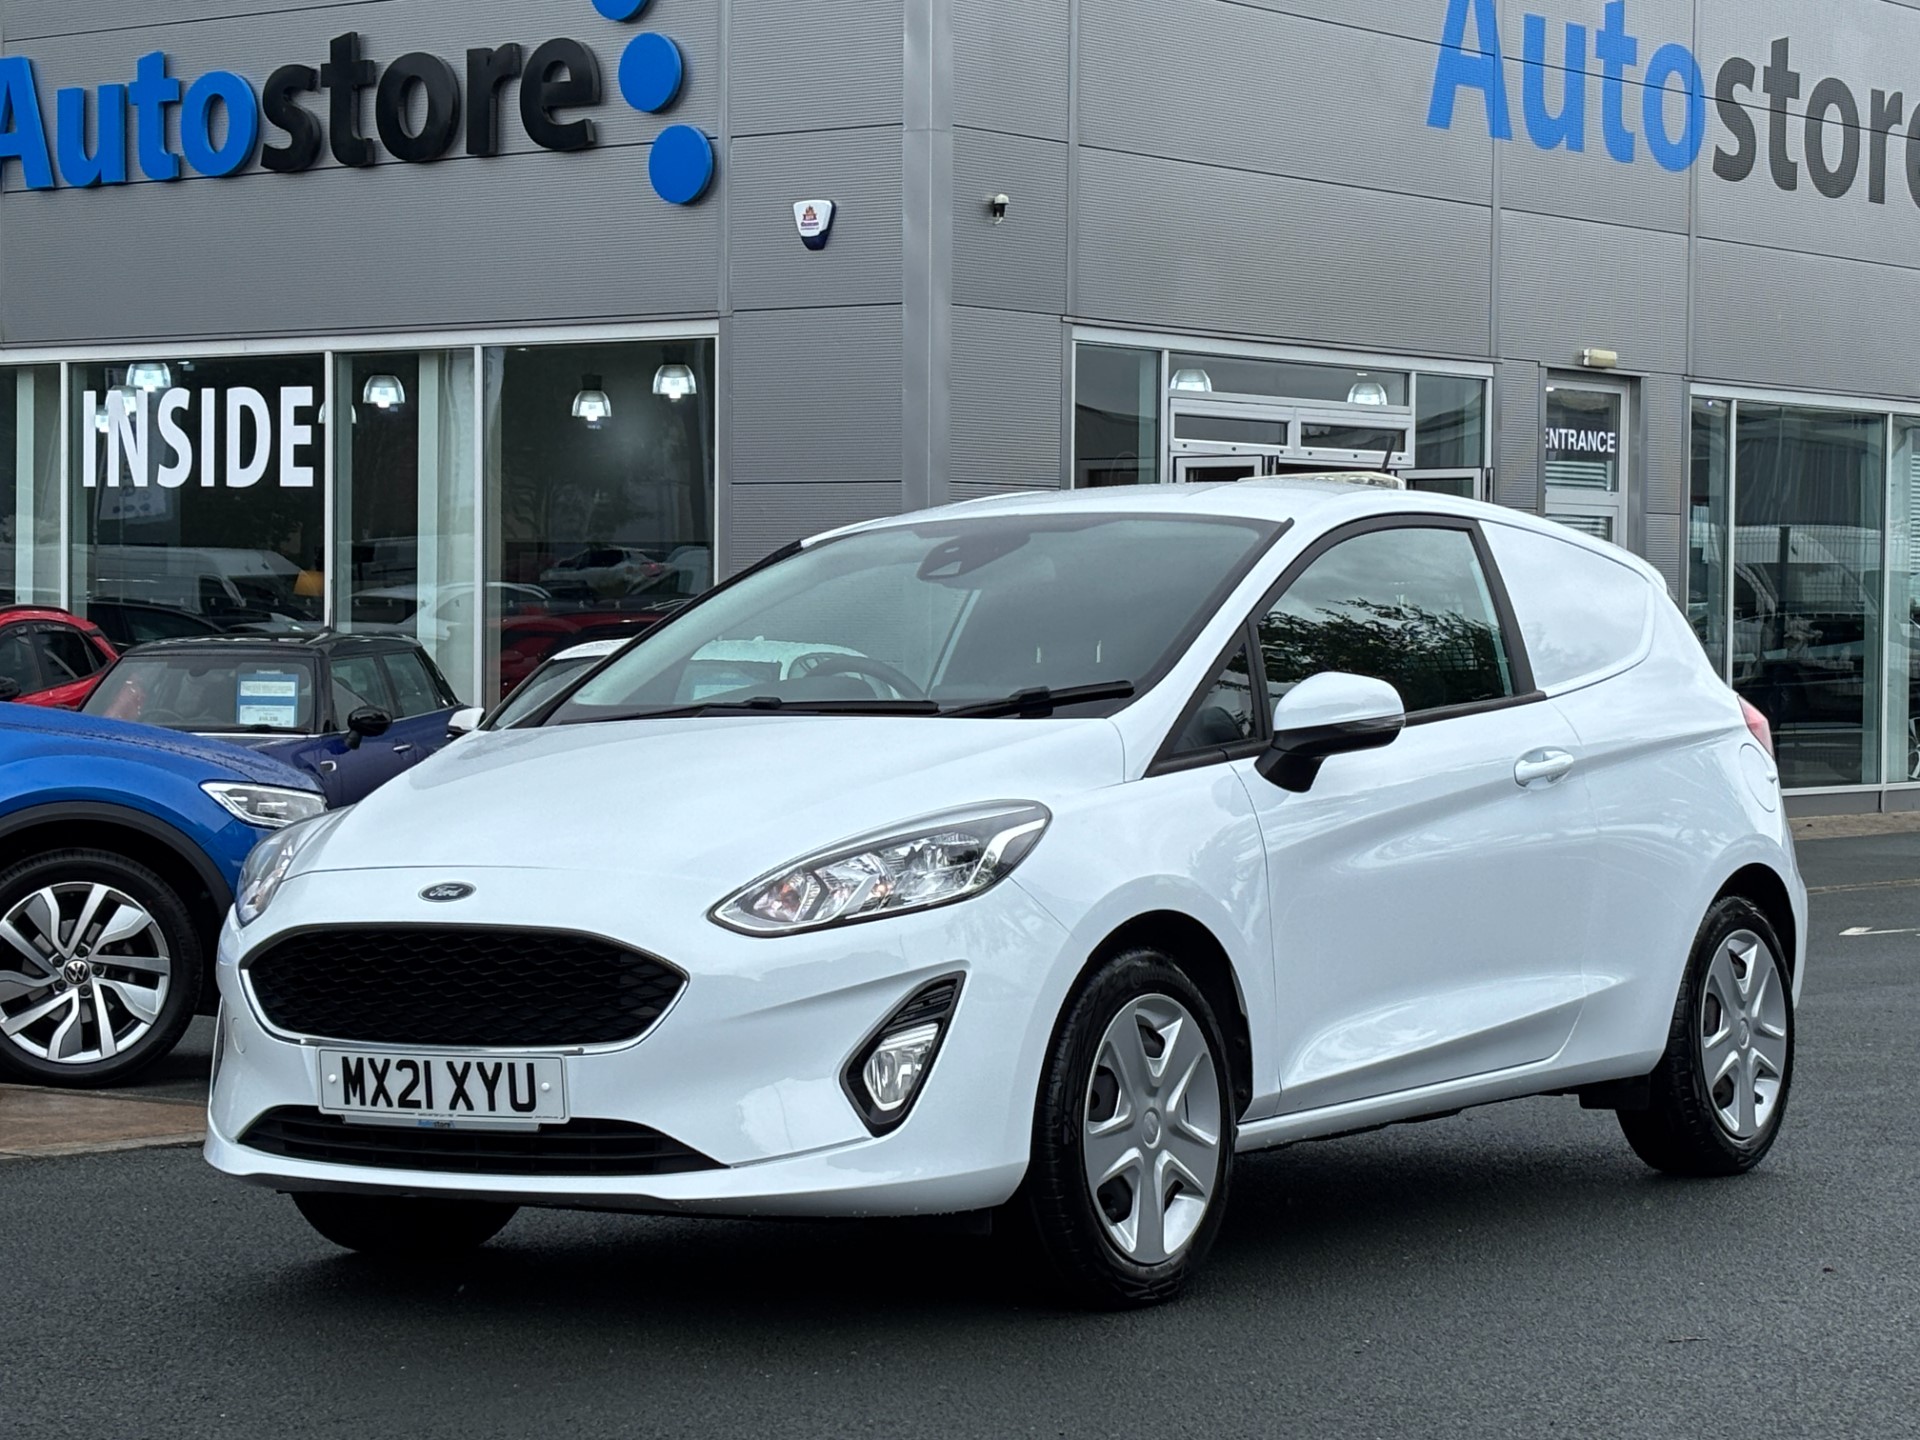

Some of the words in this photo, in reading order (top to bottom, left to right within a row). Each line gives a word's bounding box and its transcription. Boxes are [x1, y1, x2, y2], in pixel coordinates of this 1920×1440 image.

[0, 32, 600, 190] Autostore
[1427, 0, 1920, 209] Autostor
[83, 386, 313, 488] INSIDE
[342, 1056, 434, 1110] MX21
[447, 1060, 536, 1113] XYU
